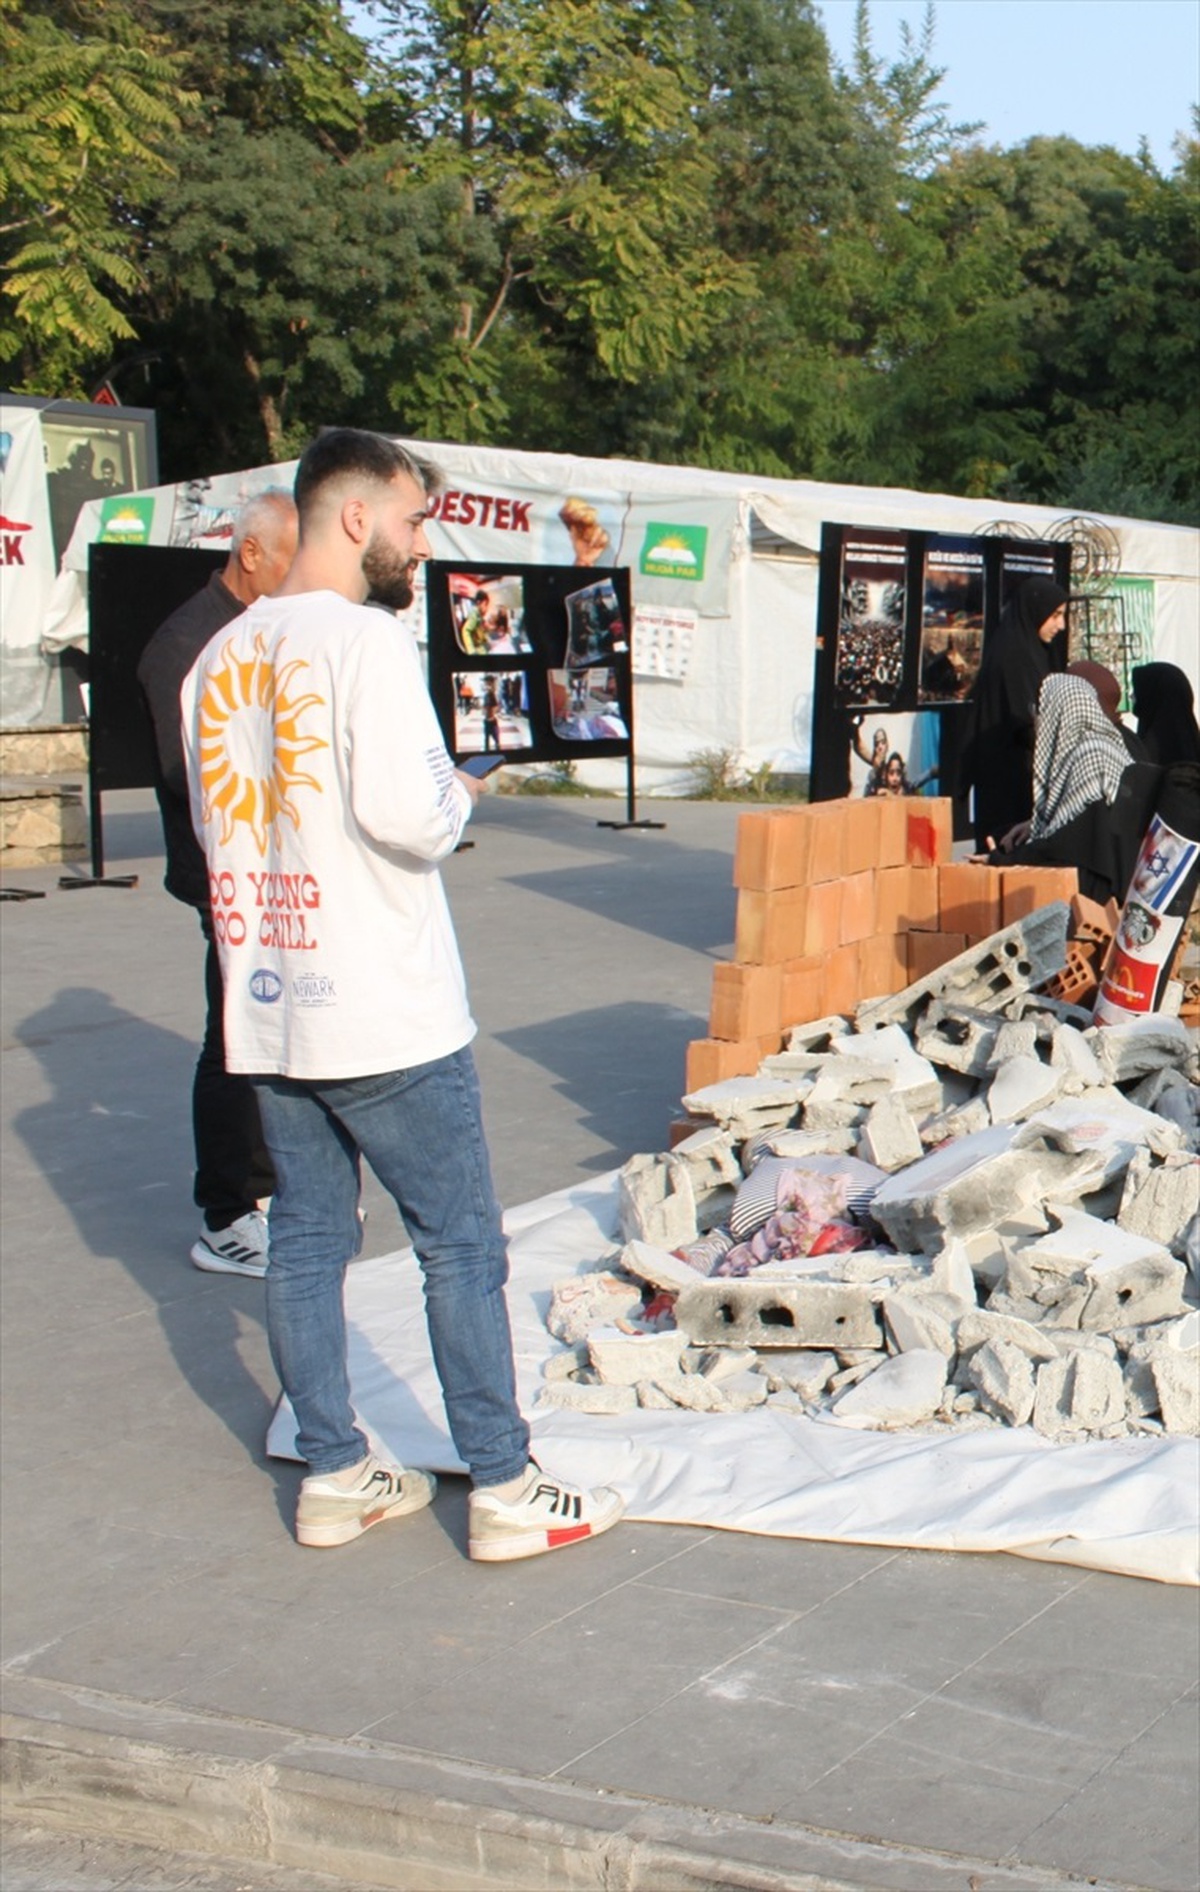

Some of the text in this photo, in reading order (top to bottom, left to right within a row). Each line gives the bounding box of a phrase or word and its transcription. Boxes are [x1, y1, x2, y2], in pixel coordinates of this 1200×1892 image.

[246, 871, 321, 910] YOUNG
[259, 912, 318, 950] CHILL
[292, 979, 337, 998] NEWARK
